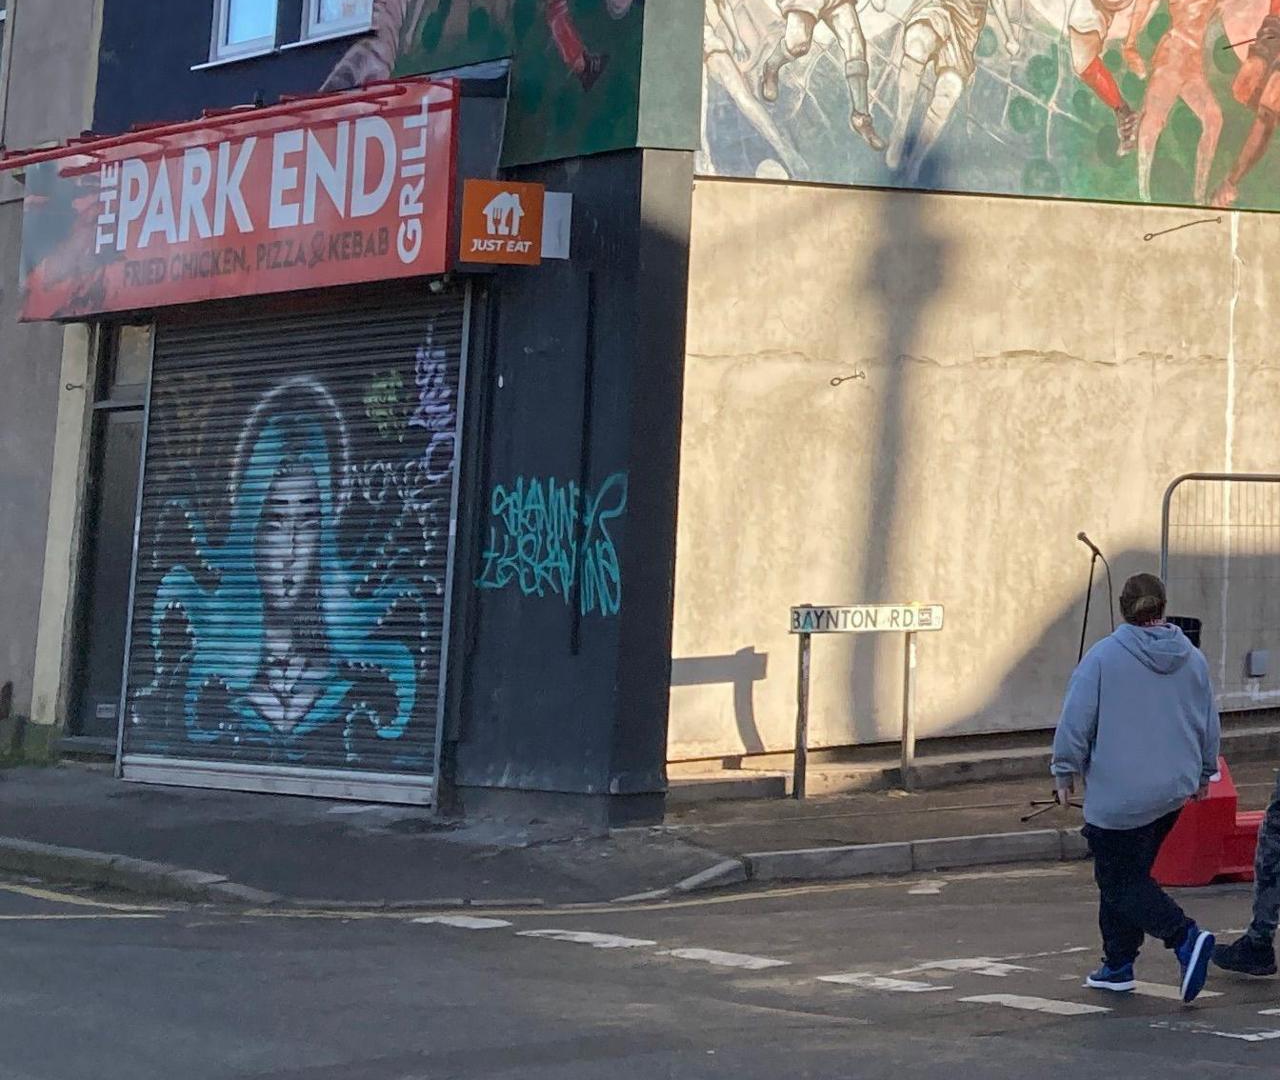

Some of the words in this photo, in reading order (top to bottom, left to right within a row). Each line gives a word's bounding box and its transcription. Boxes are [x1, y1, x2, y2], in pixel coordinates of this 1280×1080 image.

[94, 159, 120, 255] THE
[117, 136, 257, 253] PARK
[268, 115, 397, 231] END
[396, 96, 430, 265] GRILL
[123, 257, 168, 287] FRIED
[256, 239, 305, 271] PIZZA
[327, 227, 389, 261] KEBAB
[470, 238, 505, 253] JUST
[506, 240, 533, 254] EAT
[792, 608, 878, 630] BAYNTON
[889, 608, 914, 628] RD
